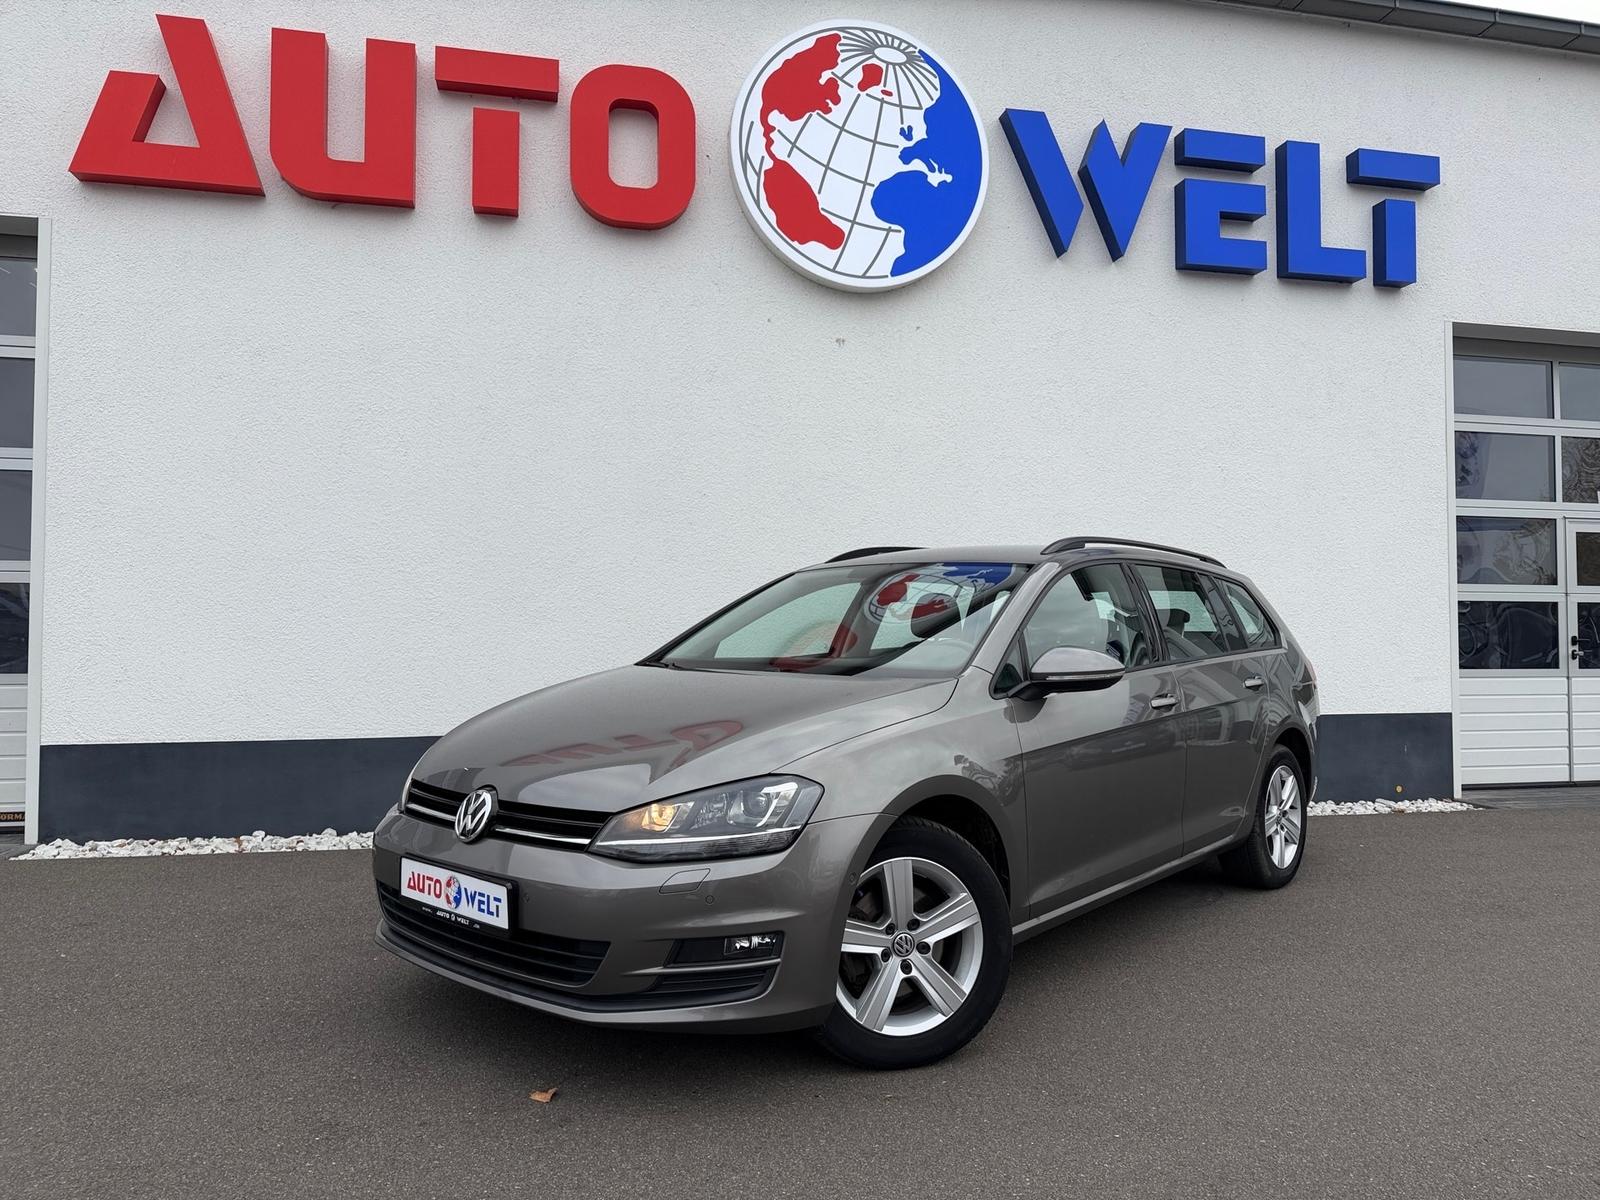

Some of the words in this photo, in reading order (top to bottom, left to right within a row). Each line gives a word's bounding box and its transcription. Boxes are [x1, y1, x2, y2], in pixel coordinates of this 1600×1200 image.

[69, 14, 697, 230] AUTO
[999, 107, 1440, 289] WELT
[407, 872, 442, 899] AUTO
[464, 888, 501, 917] WELT
